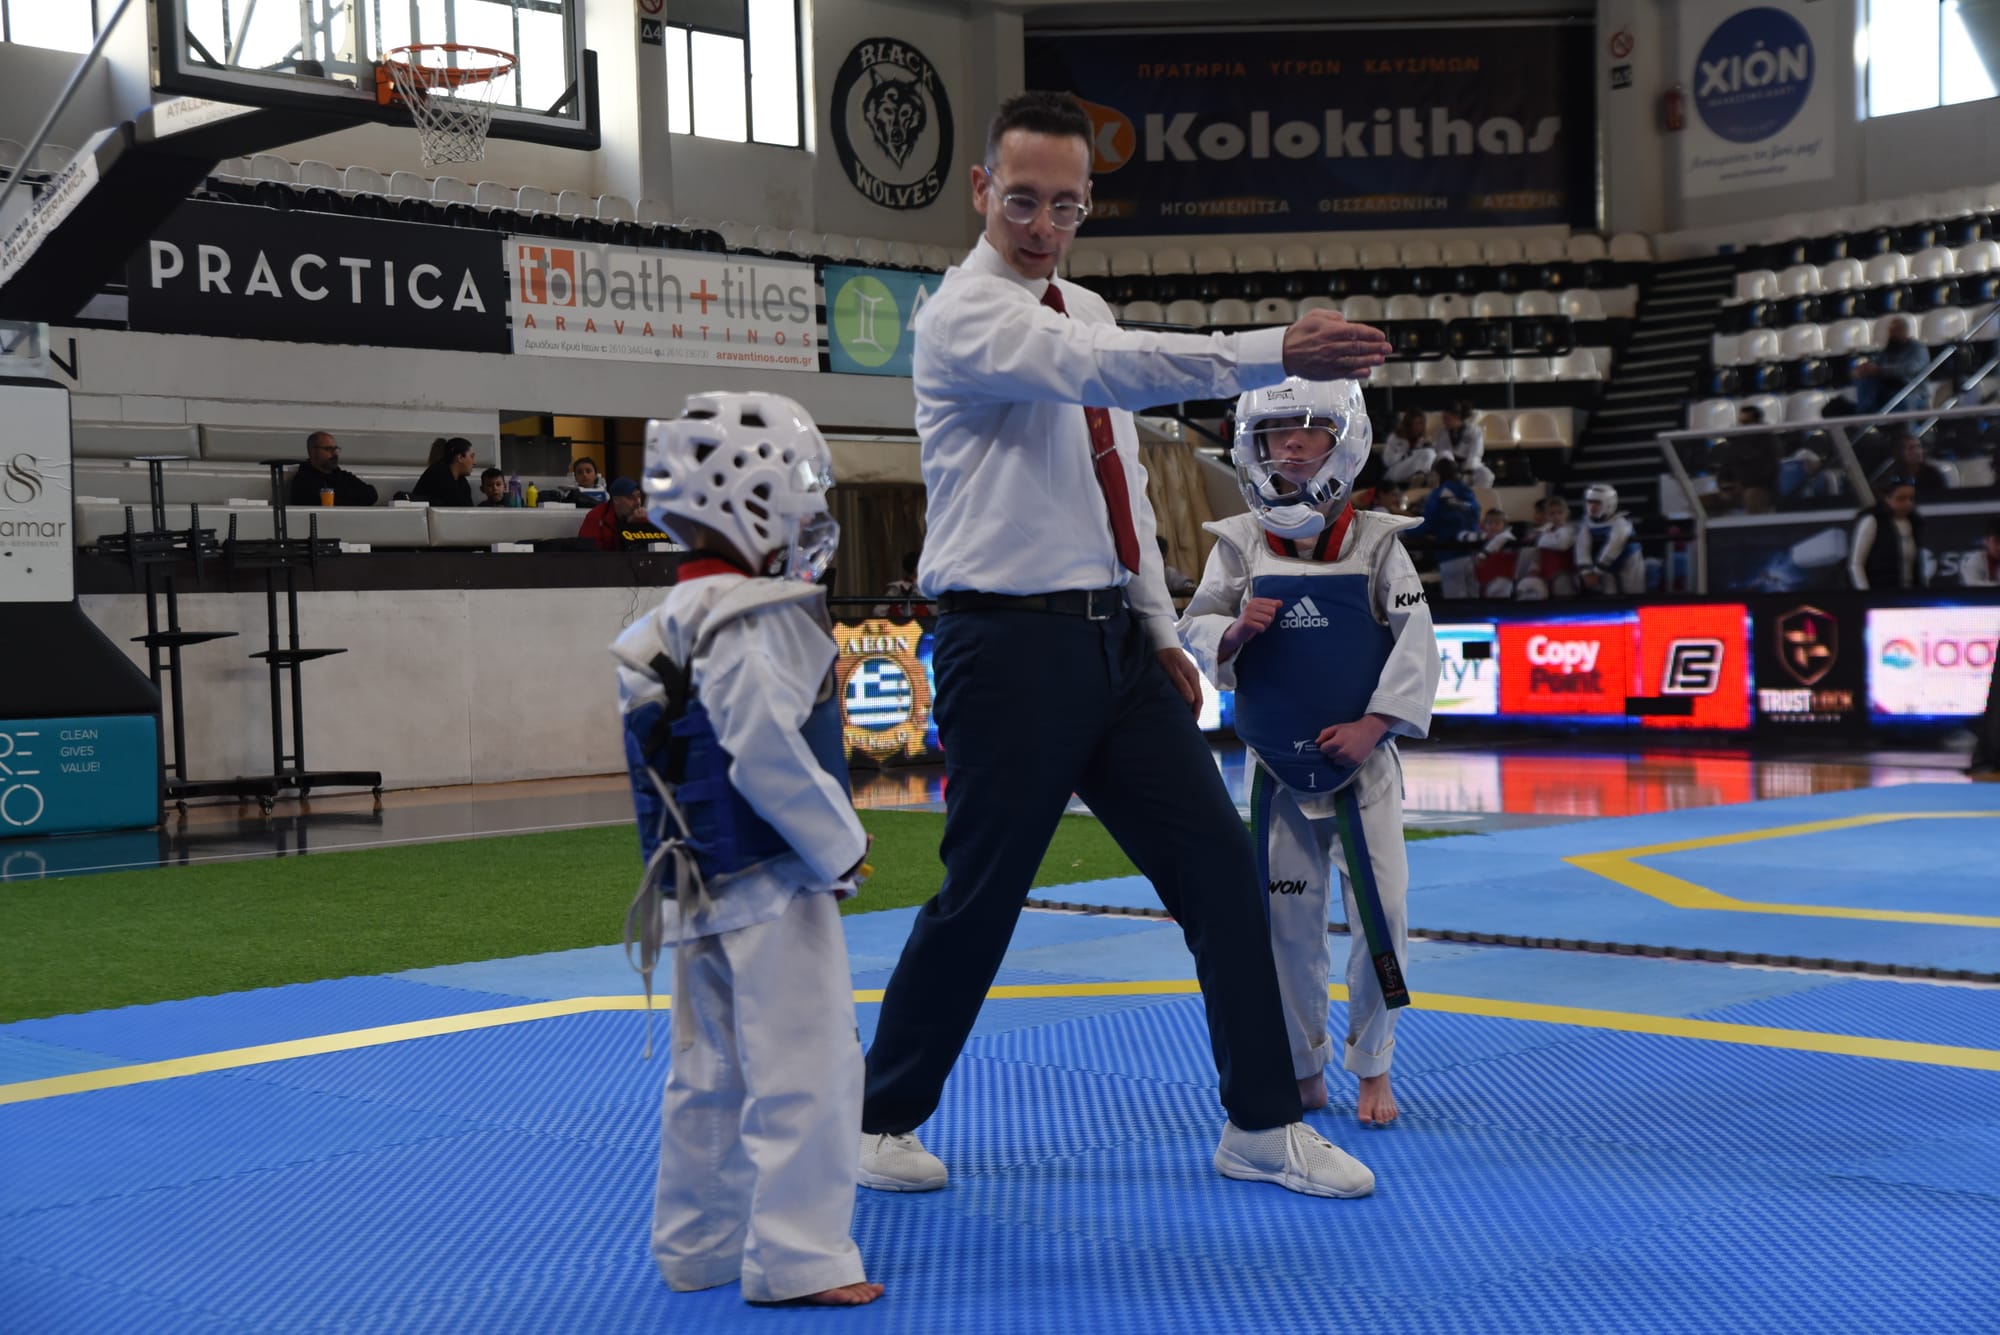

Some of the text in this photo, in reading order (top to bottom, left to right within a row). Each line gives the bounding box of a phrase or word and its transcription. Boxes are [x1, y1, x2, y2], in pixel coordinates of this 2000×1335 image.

[859, 42, 935, 92] BLACK
[1137, 62, 1247, 79] ΠΡΑΤΗΡΙΑ
[1269, 60, 1342, 76] ΥΓΡΩΝ
[1144, 106, 1562, 161] Kolokithas
[854, 158, 940, 206] WOLVES
[150, 239, 487, 313] PRACTICA
[523, 313, 812, 348] ARAVANTINOS
[716, 350, 813, 367] aravantinos.com.gr
[1280, 615, 1329, 629] adidas
[1526, 635, 1600, 676] Copy
[60, 730, 98, 741] CLEAN
[60, 746, 94, 757] GIVES
[61, 761, 100, 773] VALUE!
[1307, 772, 1318, 788] 1
